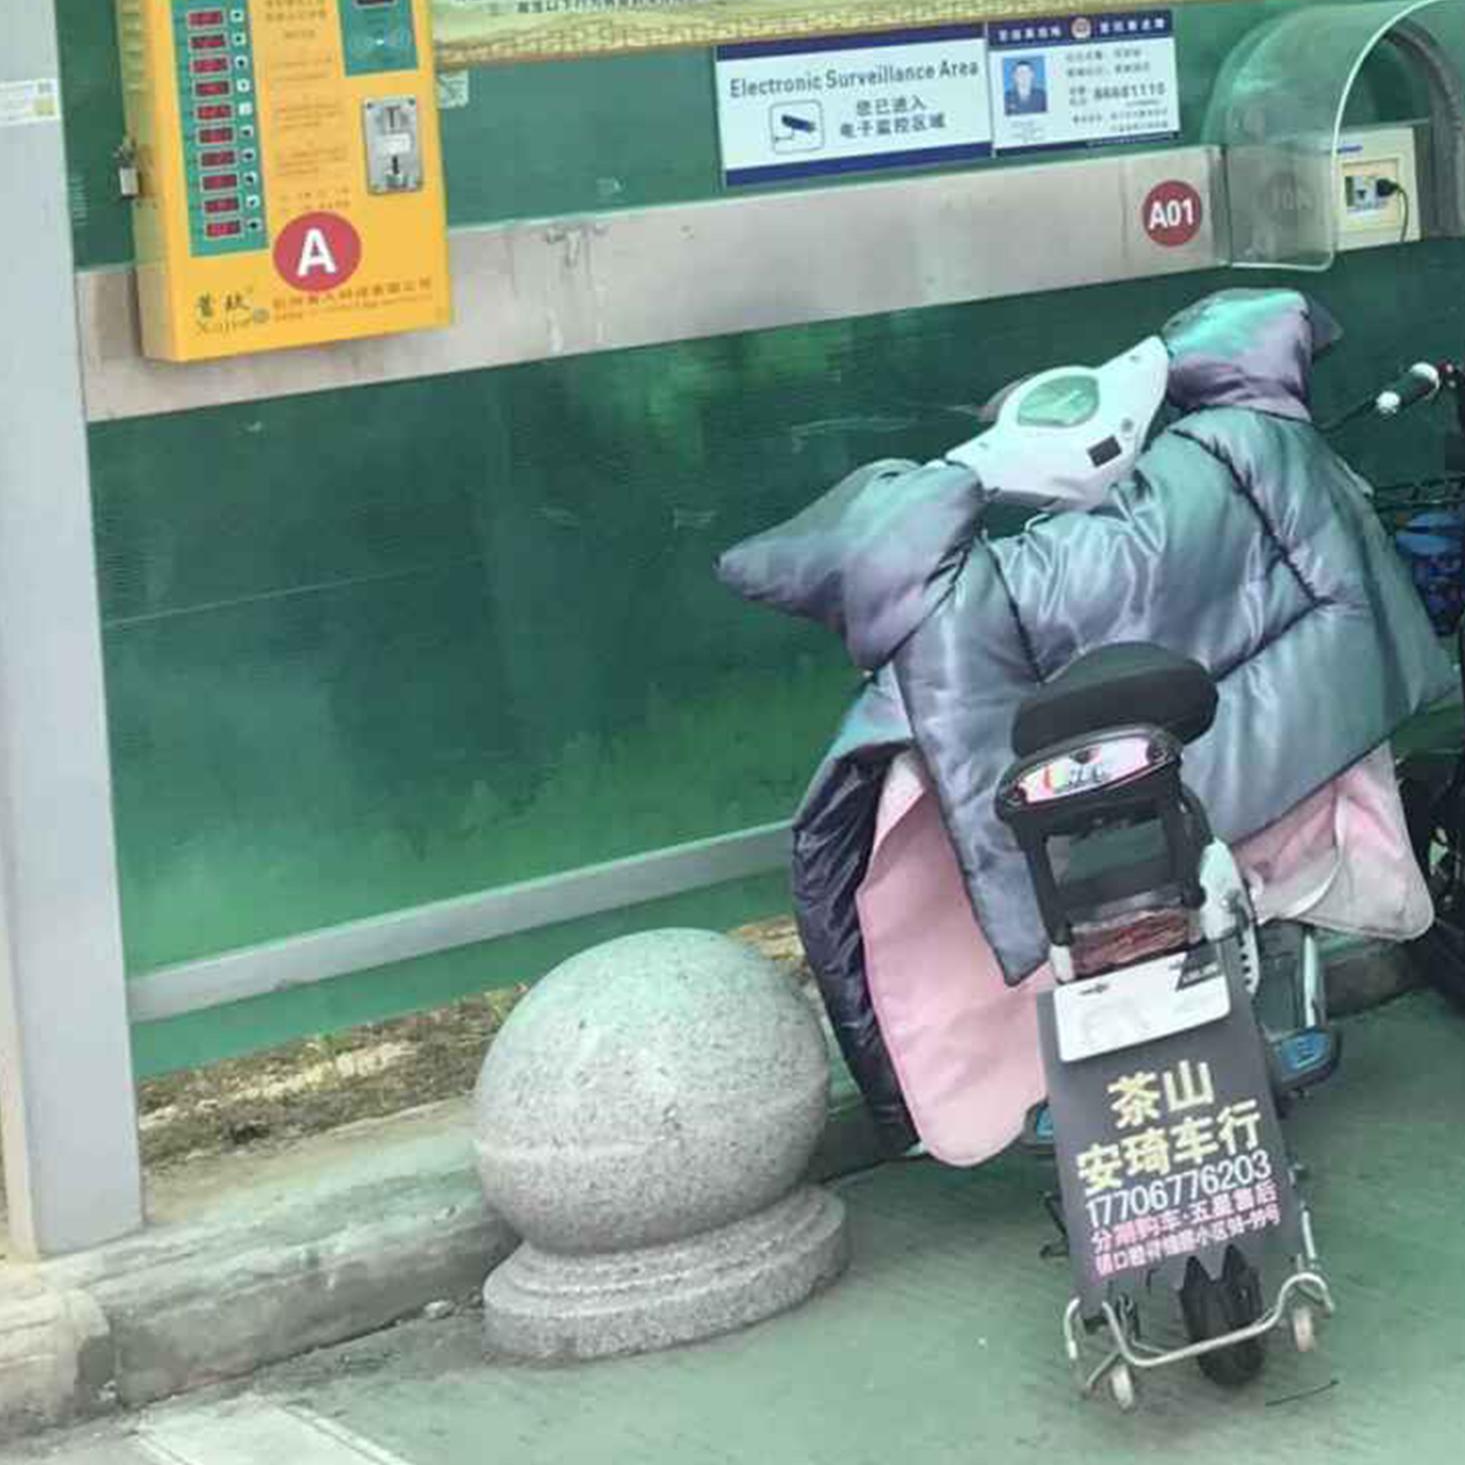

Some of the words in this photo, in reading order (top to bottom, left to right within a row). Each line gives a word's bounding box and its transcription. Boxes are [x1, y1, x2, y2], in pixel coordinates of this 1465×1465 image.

[729, 70, 823, 99] Electronic
[825, 63, 936, 92] Surveillance
[938, 58, 979, 79] Area
[838, 112, 946, 138] 电子监控区域
[855, 95, 928, 116] 您已进入
[1148, 198, 1195, 231] A01
[297, 228, 337, 277] A
[1106, 1059, 1215, 1130] 茶山
[1075, 1098, 1262, 1197] 安琦车行
[1084, 1148, 1273, 1229] 17706776203
